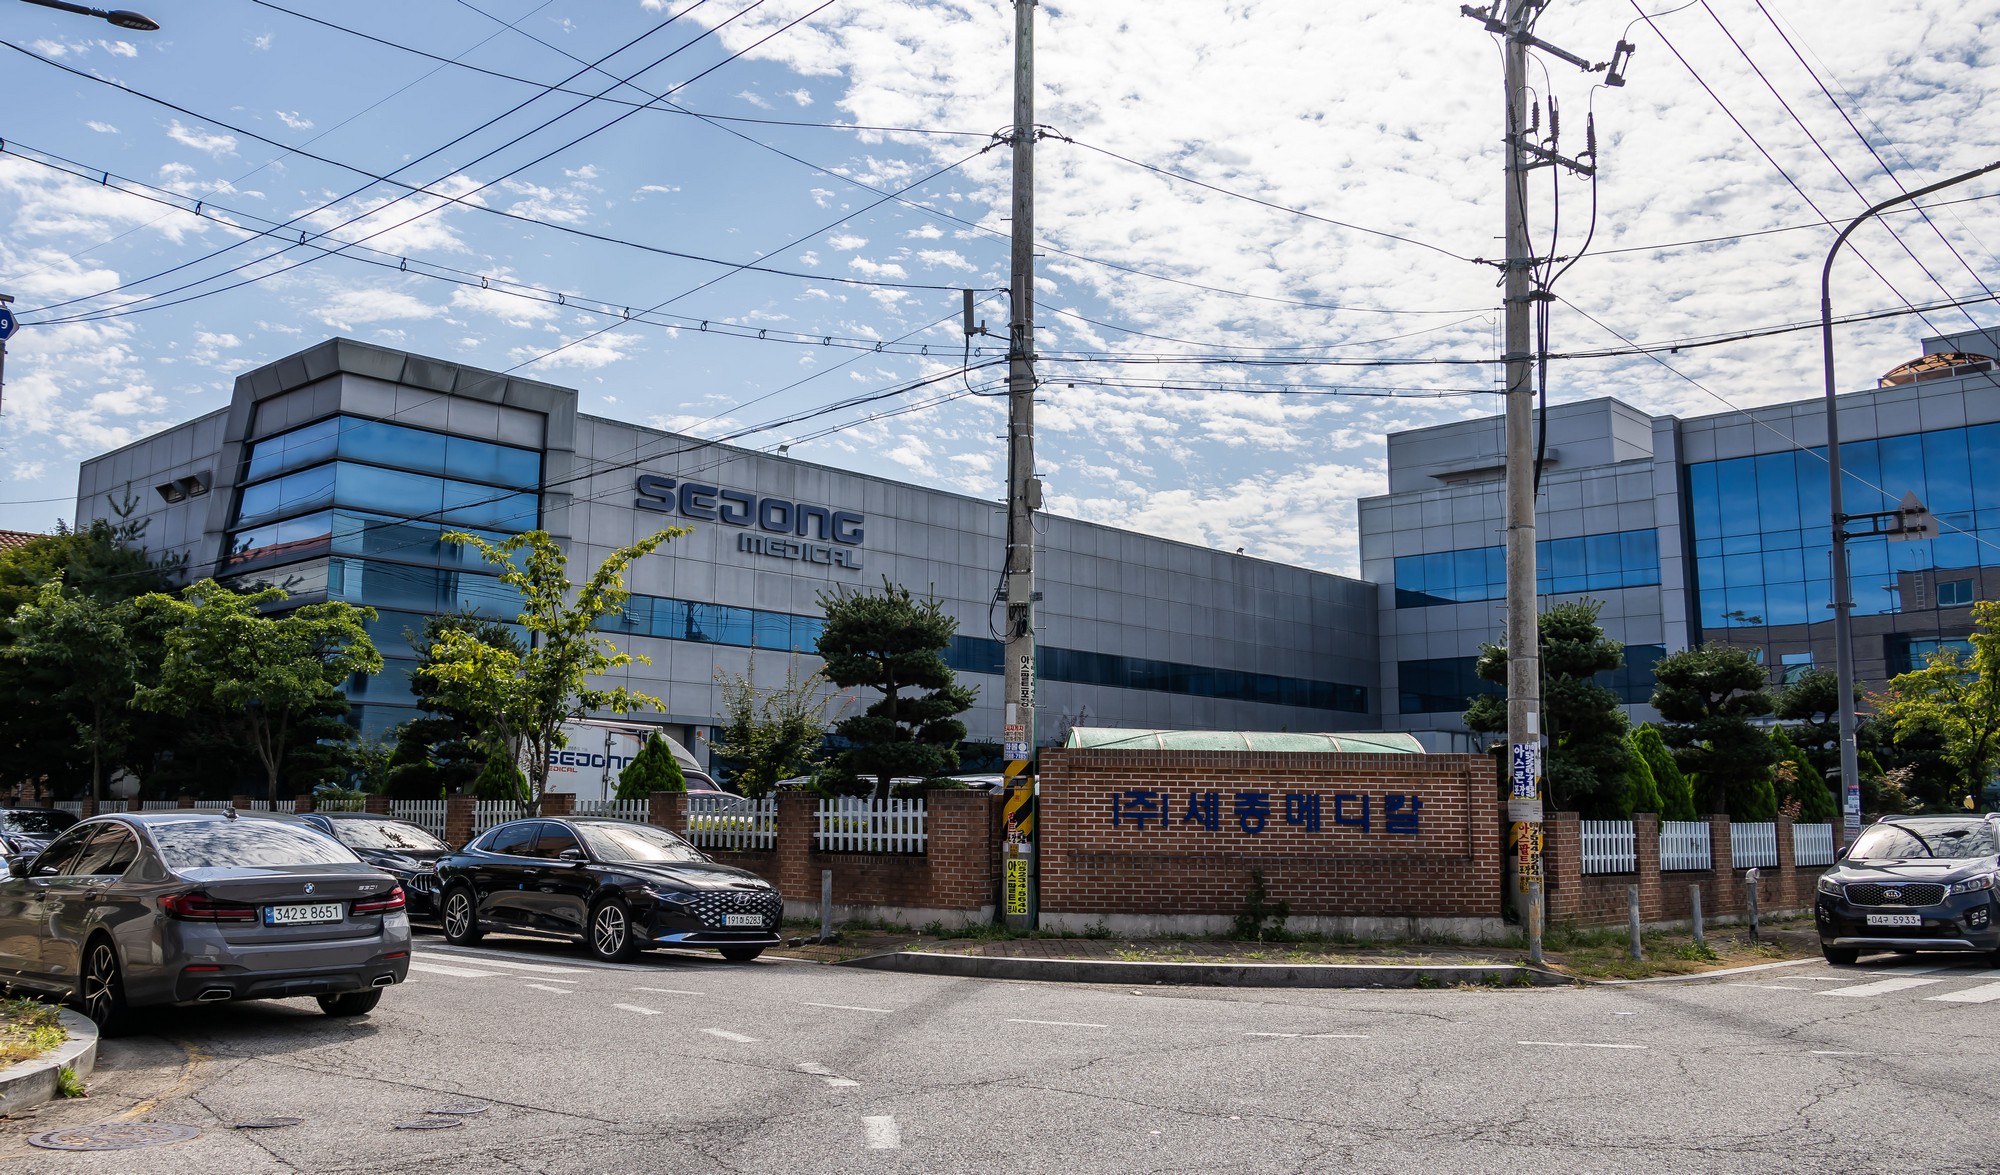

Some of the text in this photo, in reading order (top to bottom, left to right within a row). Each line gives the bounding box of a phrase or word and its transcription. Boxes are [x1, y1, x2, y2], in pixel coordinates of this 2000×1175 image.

[636, 474, 865, 545] SEJONG
[739, 532, 864, 570] MEDICAL
[1514, 744, 1525, 784] 아스콘
[1008, 861, 1016, 904] 아스팔트
[275, 905, 339, 920] 342오 8651
[745, 916, 760, 925] 5283
[1892, 915, 1916, 924] 5933
